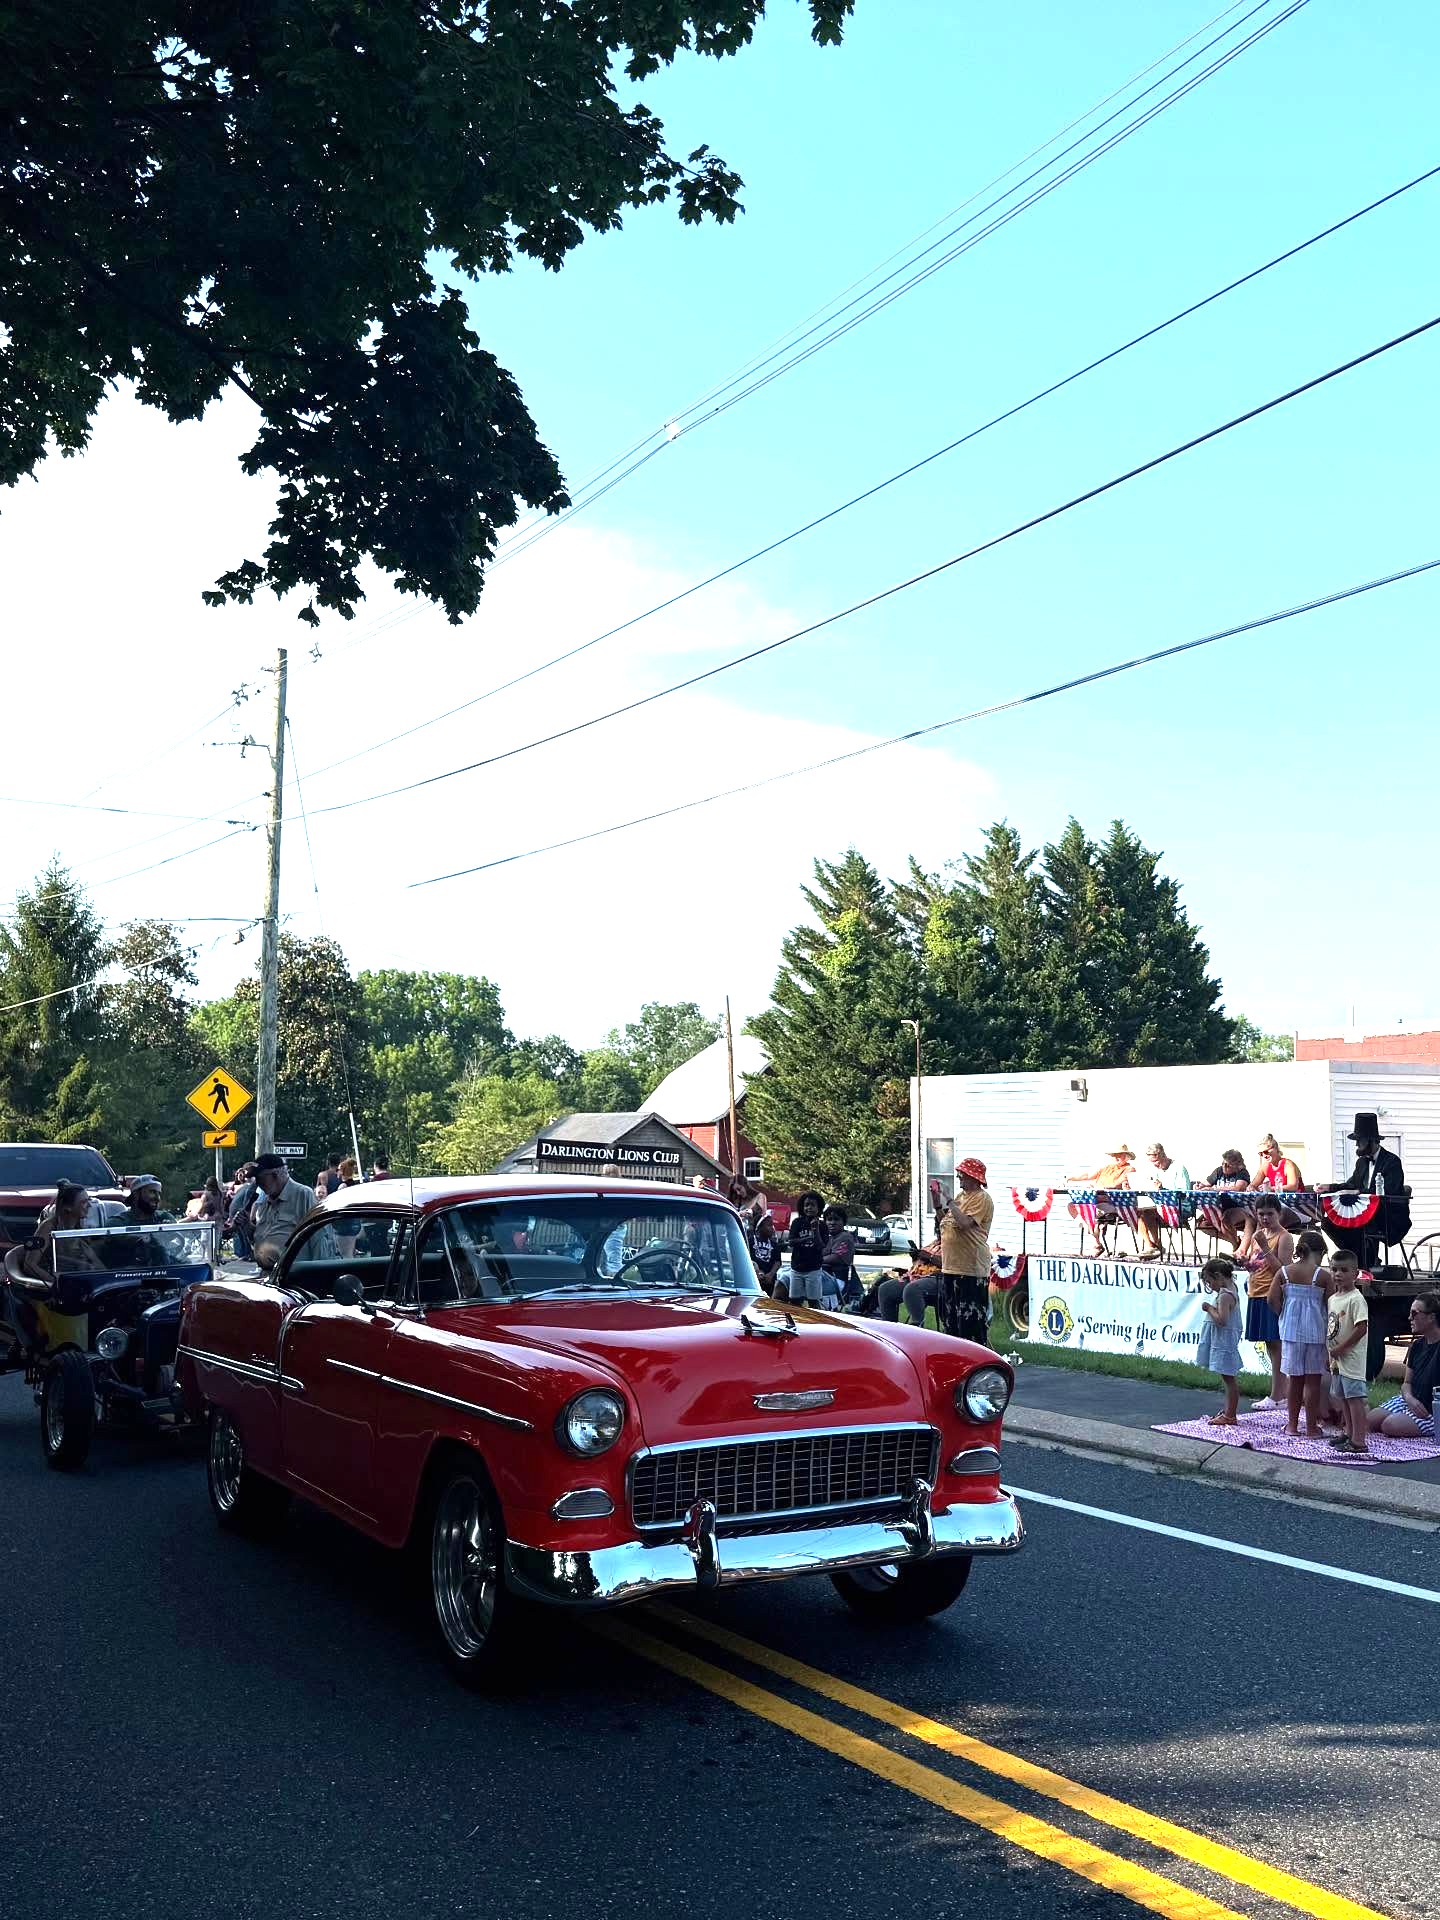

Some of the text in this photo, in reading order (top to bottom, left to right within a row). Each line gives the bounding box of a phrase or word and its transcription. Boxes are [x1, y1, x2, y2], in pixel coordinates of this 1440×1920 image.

[275, 1146, 302, 1154] ONE WAY
[541, 1142, 680, 1164] DARLINGTON LIONS CLUB
[1036, 1259, 1067, 1283] THE
[1071, 1261, 1180, 1293] DARLINGTON
[1051, 1311, 1062, 1332] L
[1136, 1322, 1157, 1342] the
